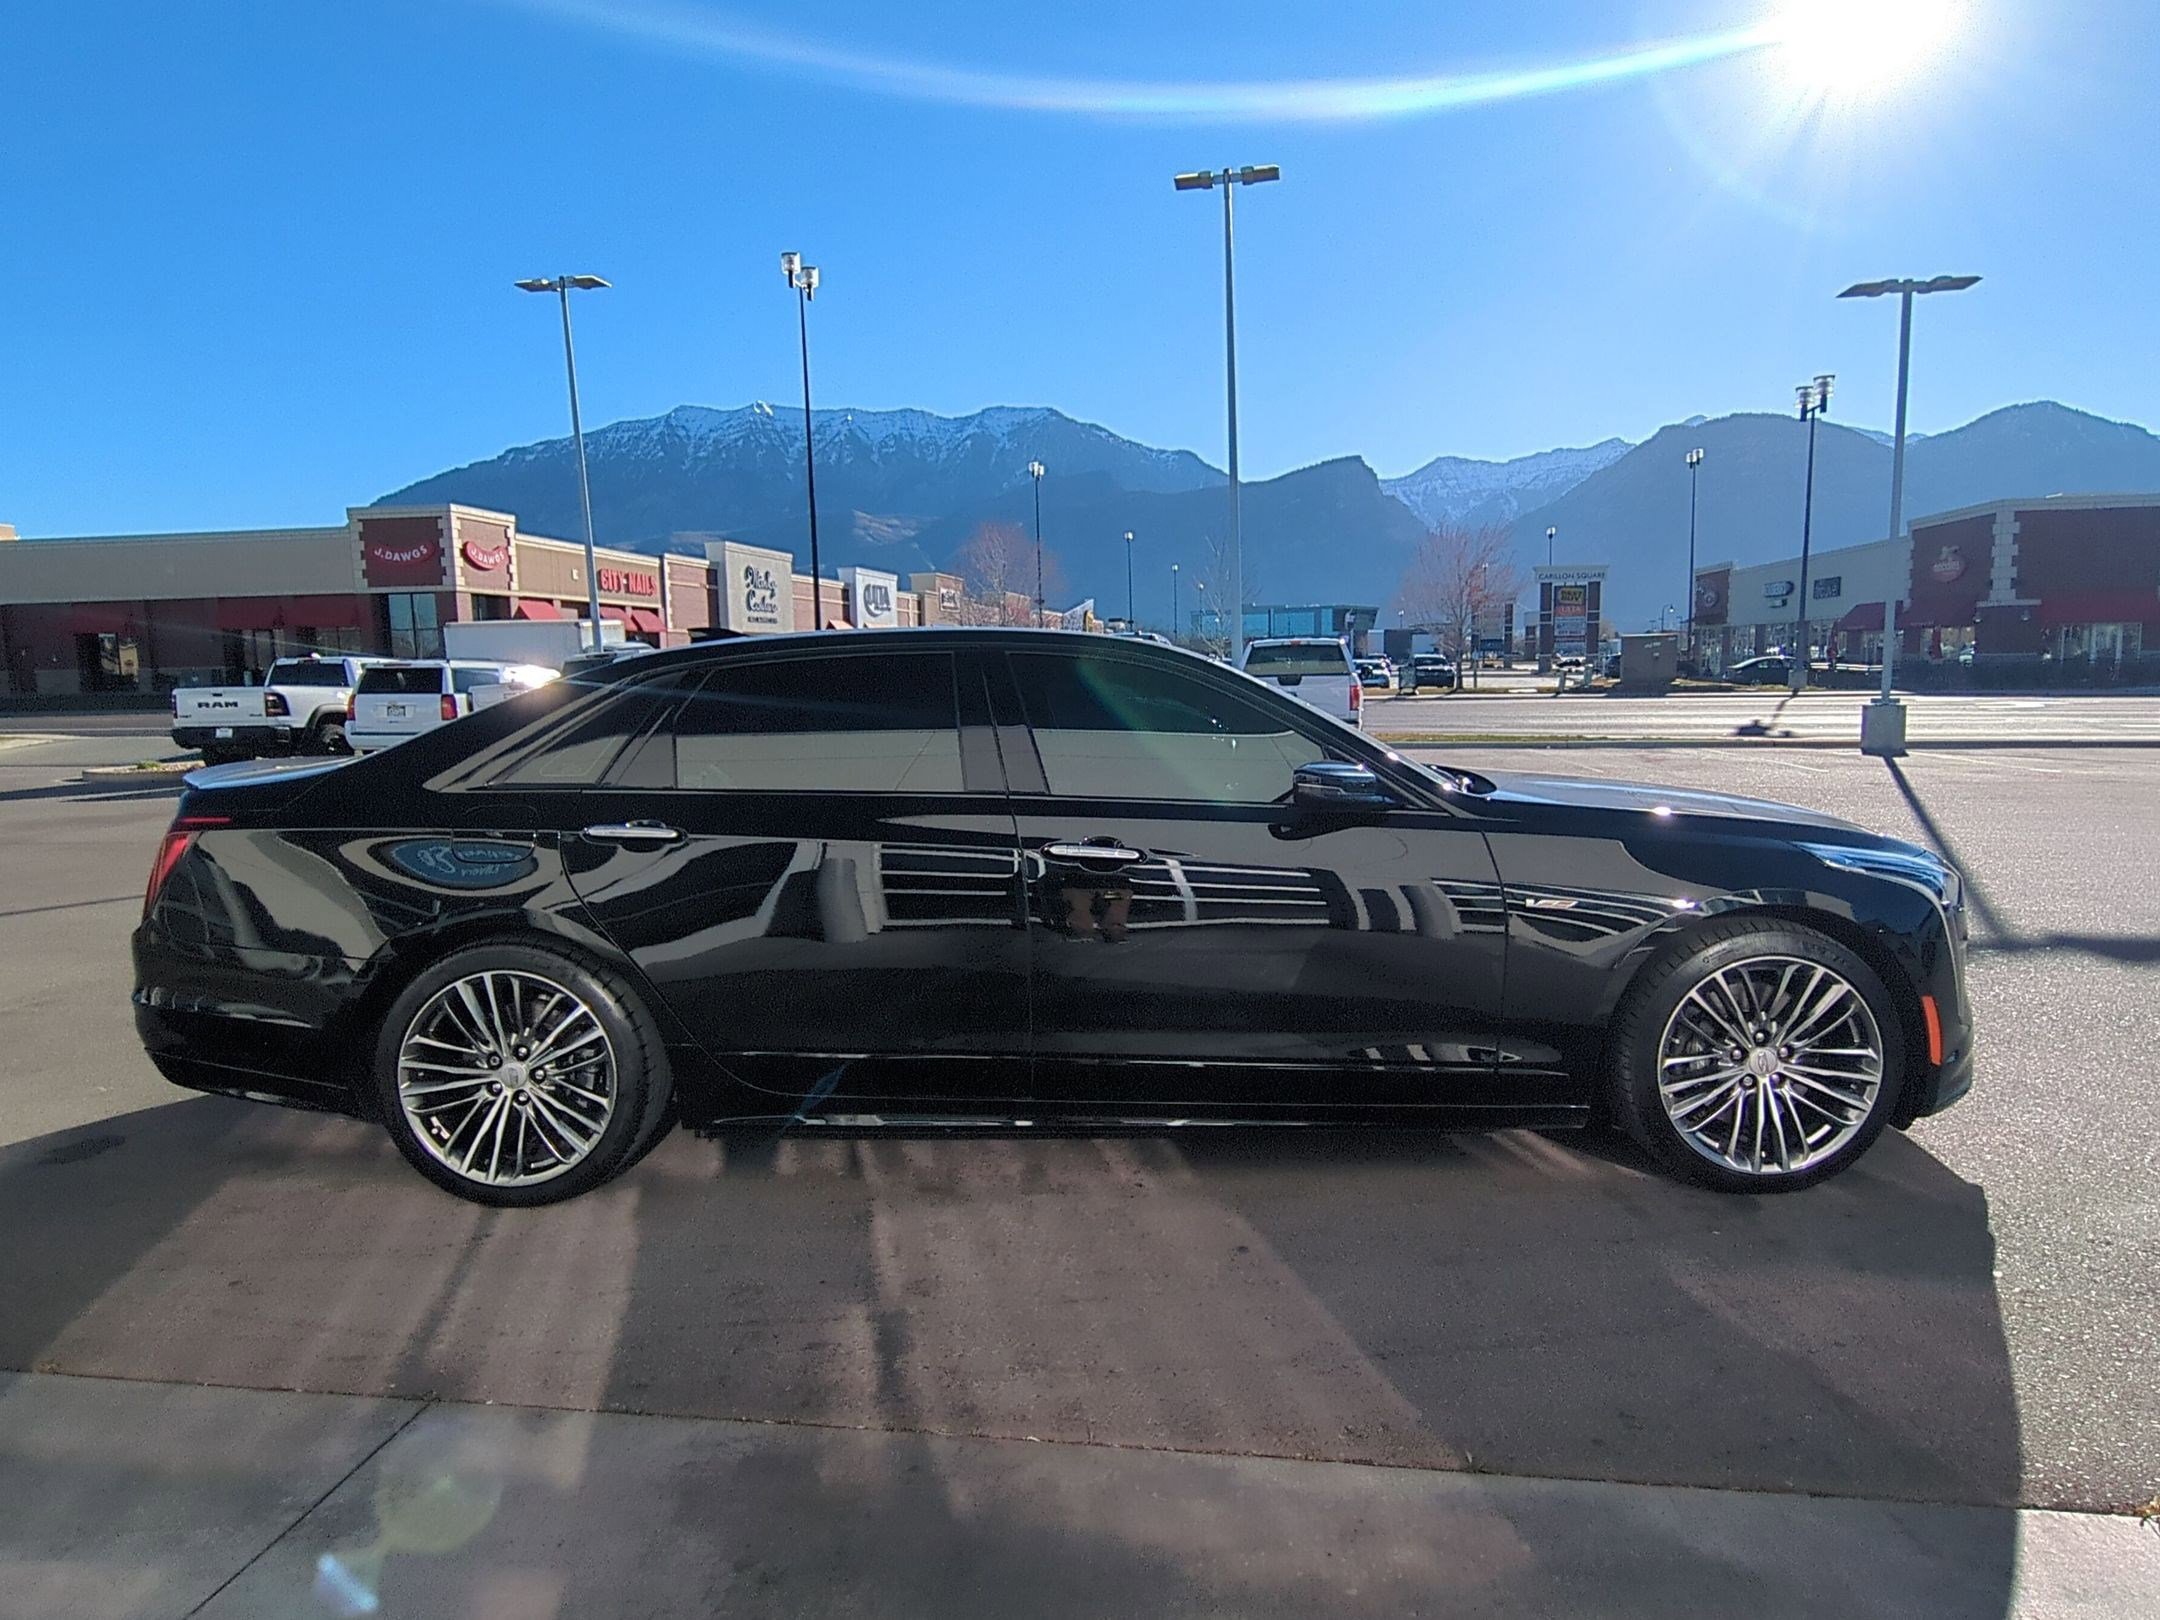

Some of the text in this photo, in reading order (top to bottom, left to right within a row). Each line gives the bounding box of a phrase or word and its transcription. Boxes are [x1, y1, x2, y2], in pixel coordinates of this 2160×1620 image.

[374, 544, 428, 562] J.DAWGS
[601, 568, 625, 593] CITY
[627, 571, 657, 597] NAILS
[197, 701, 239, 709] RAM
